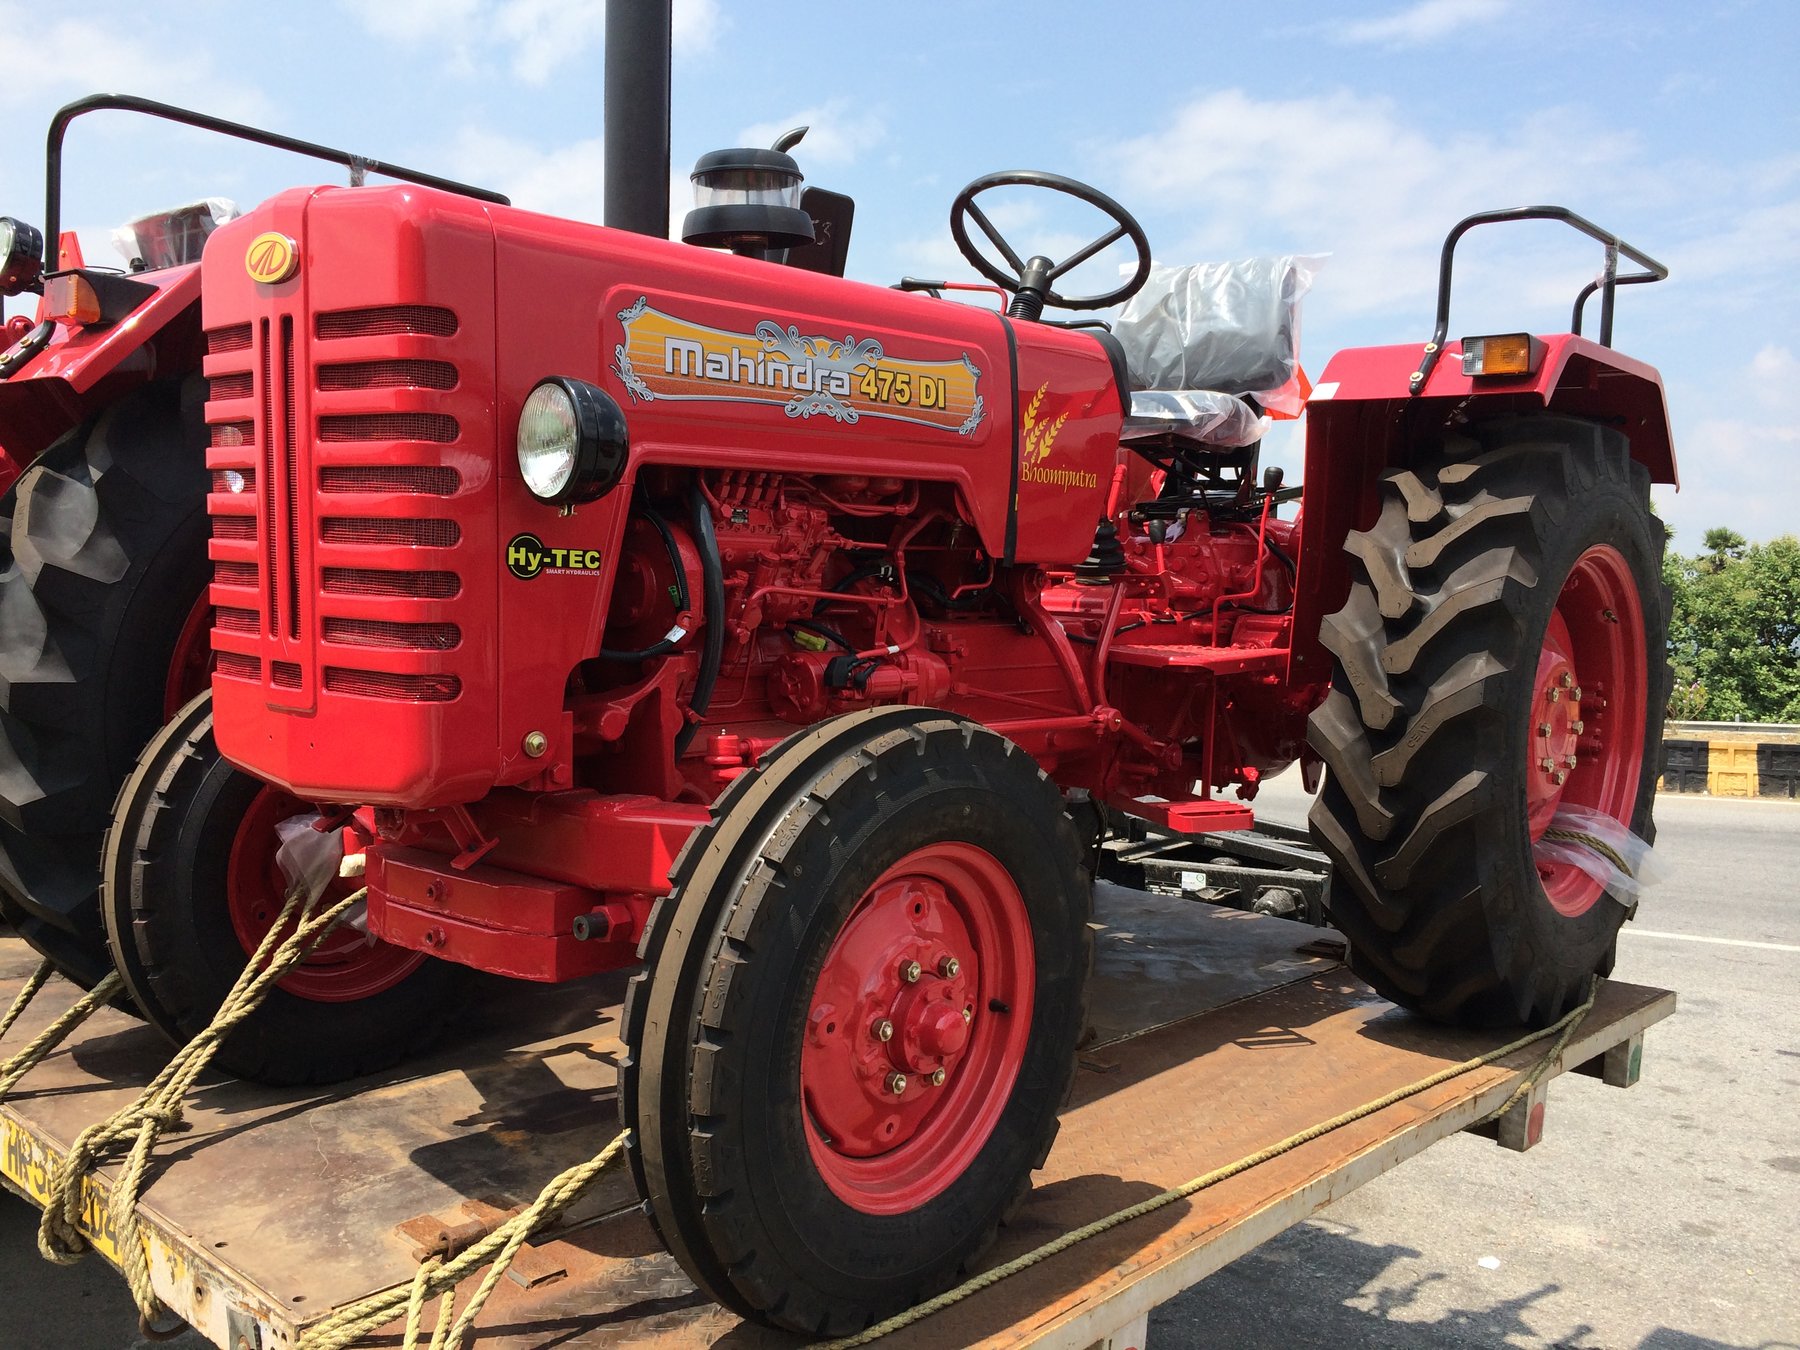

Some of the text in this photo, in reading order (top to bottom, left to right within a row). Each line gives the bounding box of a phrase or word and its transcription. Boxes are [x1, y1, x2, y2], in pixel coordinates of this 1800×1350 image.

[664, 337, 946, 409] Mahindra 475 DI
[1021, 461, 1097, 493] Bhoomiputra
[508, 546, 600, 571] Hy-TEC
[1407, 721, 1431, 749] CEAT
[779, 821, 800, 848] CEAT
[712, 977, 727, 1010] CEAT
